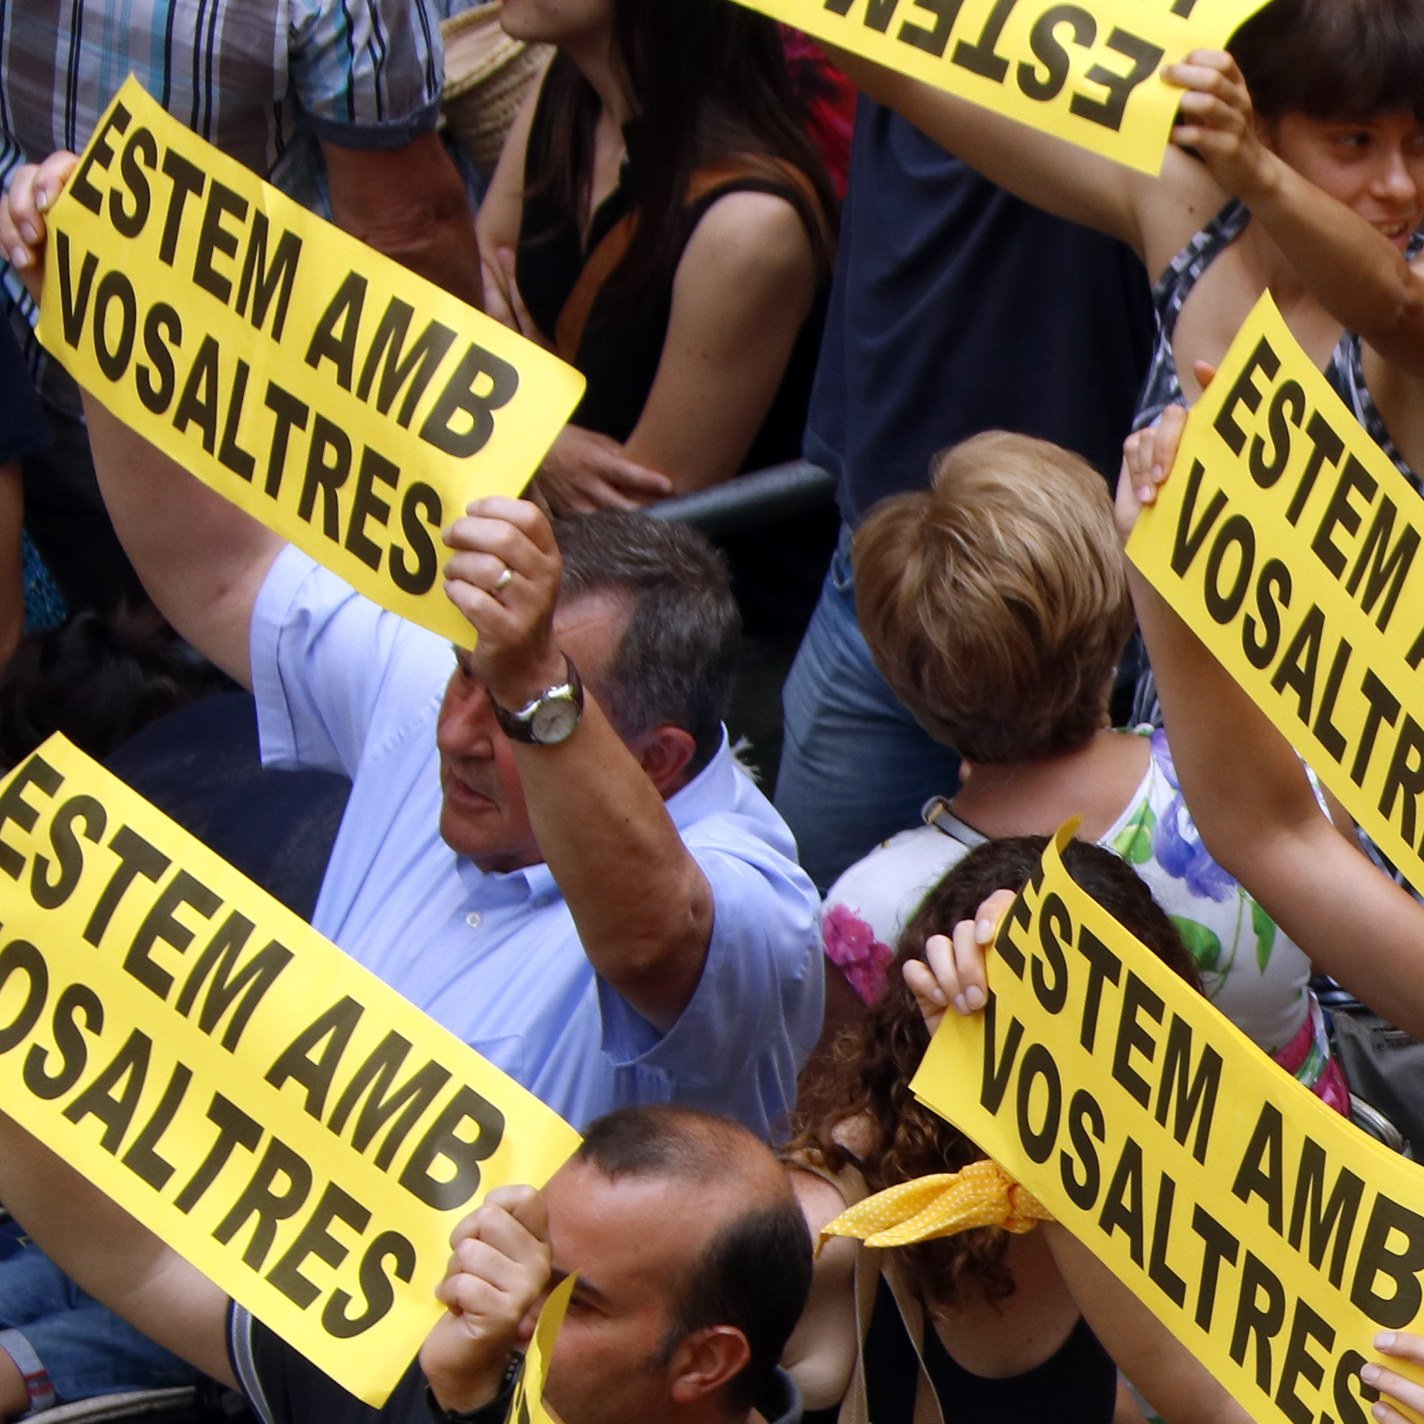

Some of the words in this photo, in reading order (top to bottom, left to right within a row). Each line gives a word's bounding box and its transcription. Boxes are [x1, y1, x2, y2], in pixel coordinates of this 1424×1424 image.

[56, 230, 444, 596] VOSALTRES
[71, 103, 303, 343] ESTEM
[306, 271, 520, 459] AMB
[1212, 335, 1422, 634] ESTEM
[0, 921, 417, 1340] OSALTRES
[264, 995, 506, 1212] AMB
[994, 868, 1225, 1166] ESTEM
